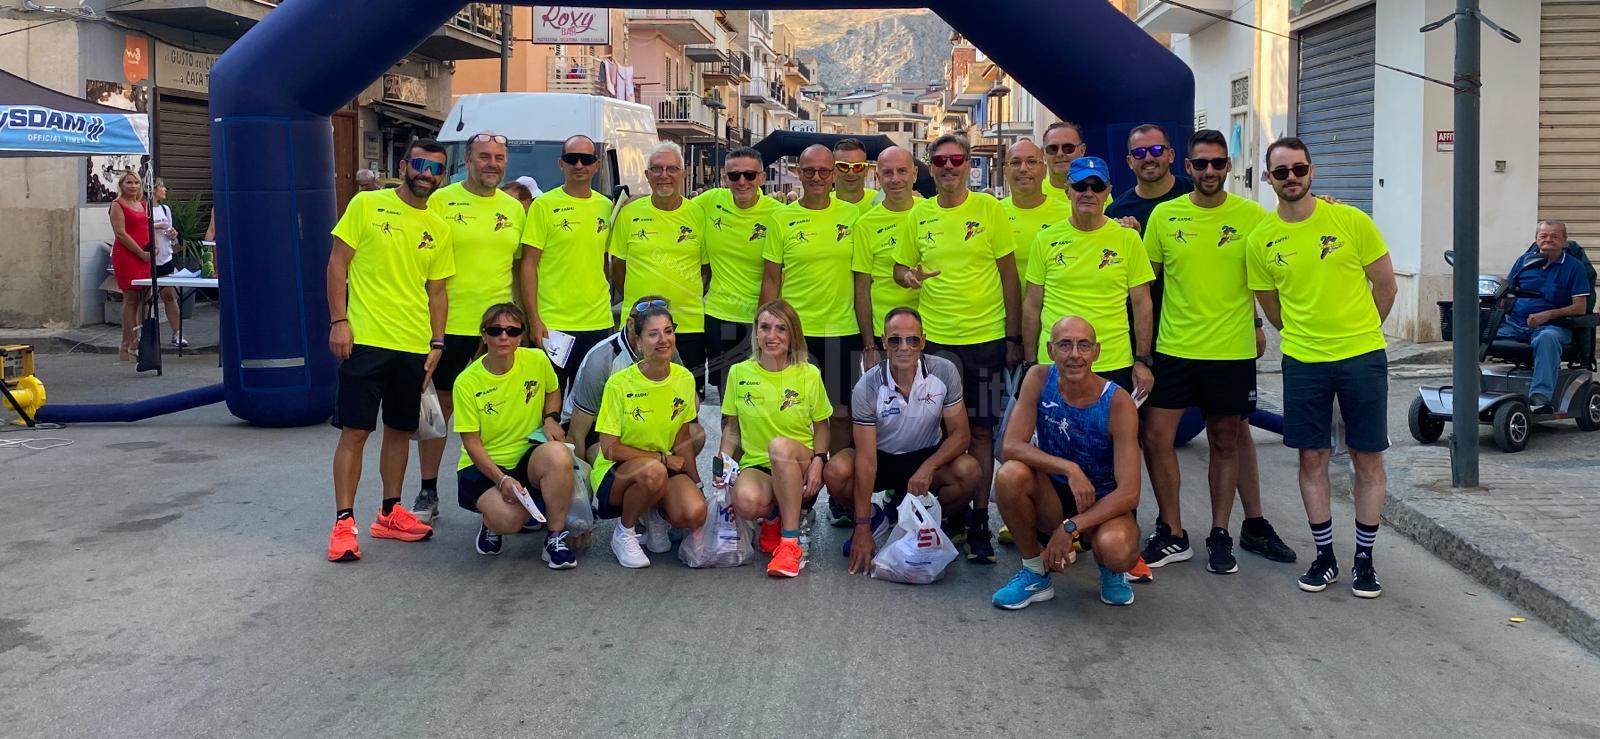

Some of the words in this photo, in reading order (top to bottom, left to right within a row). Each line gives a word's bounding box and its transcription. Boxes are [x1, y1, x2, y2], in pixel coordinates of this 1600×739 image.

[561, 26, 577, 36] BAR
[171, 49, 194, 67] GUSTO
[186, 70, 204, 86] CASA
[28, 134, 62, 143] OFFICIAL
